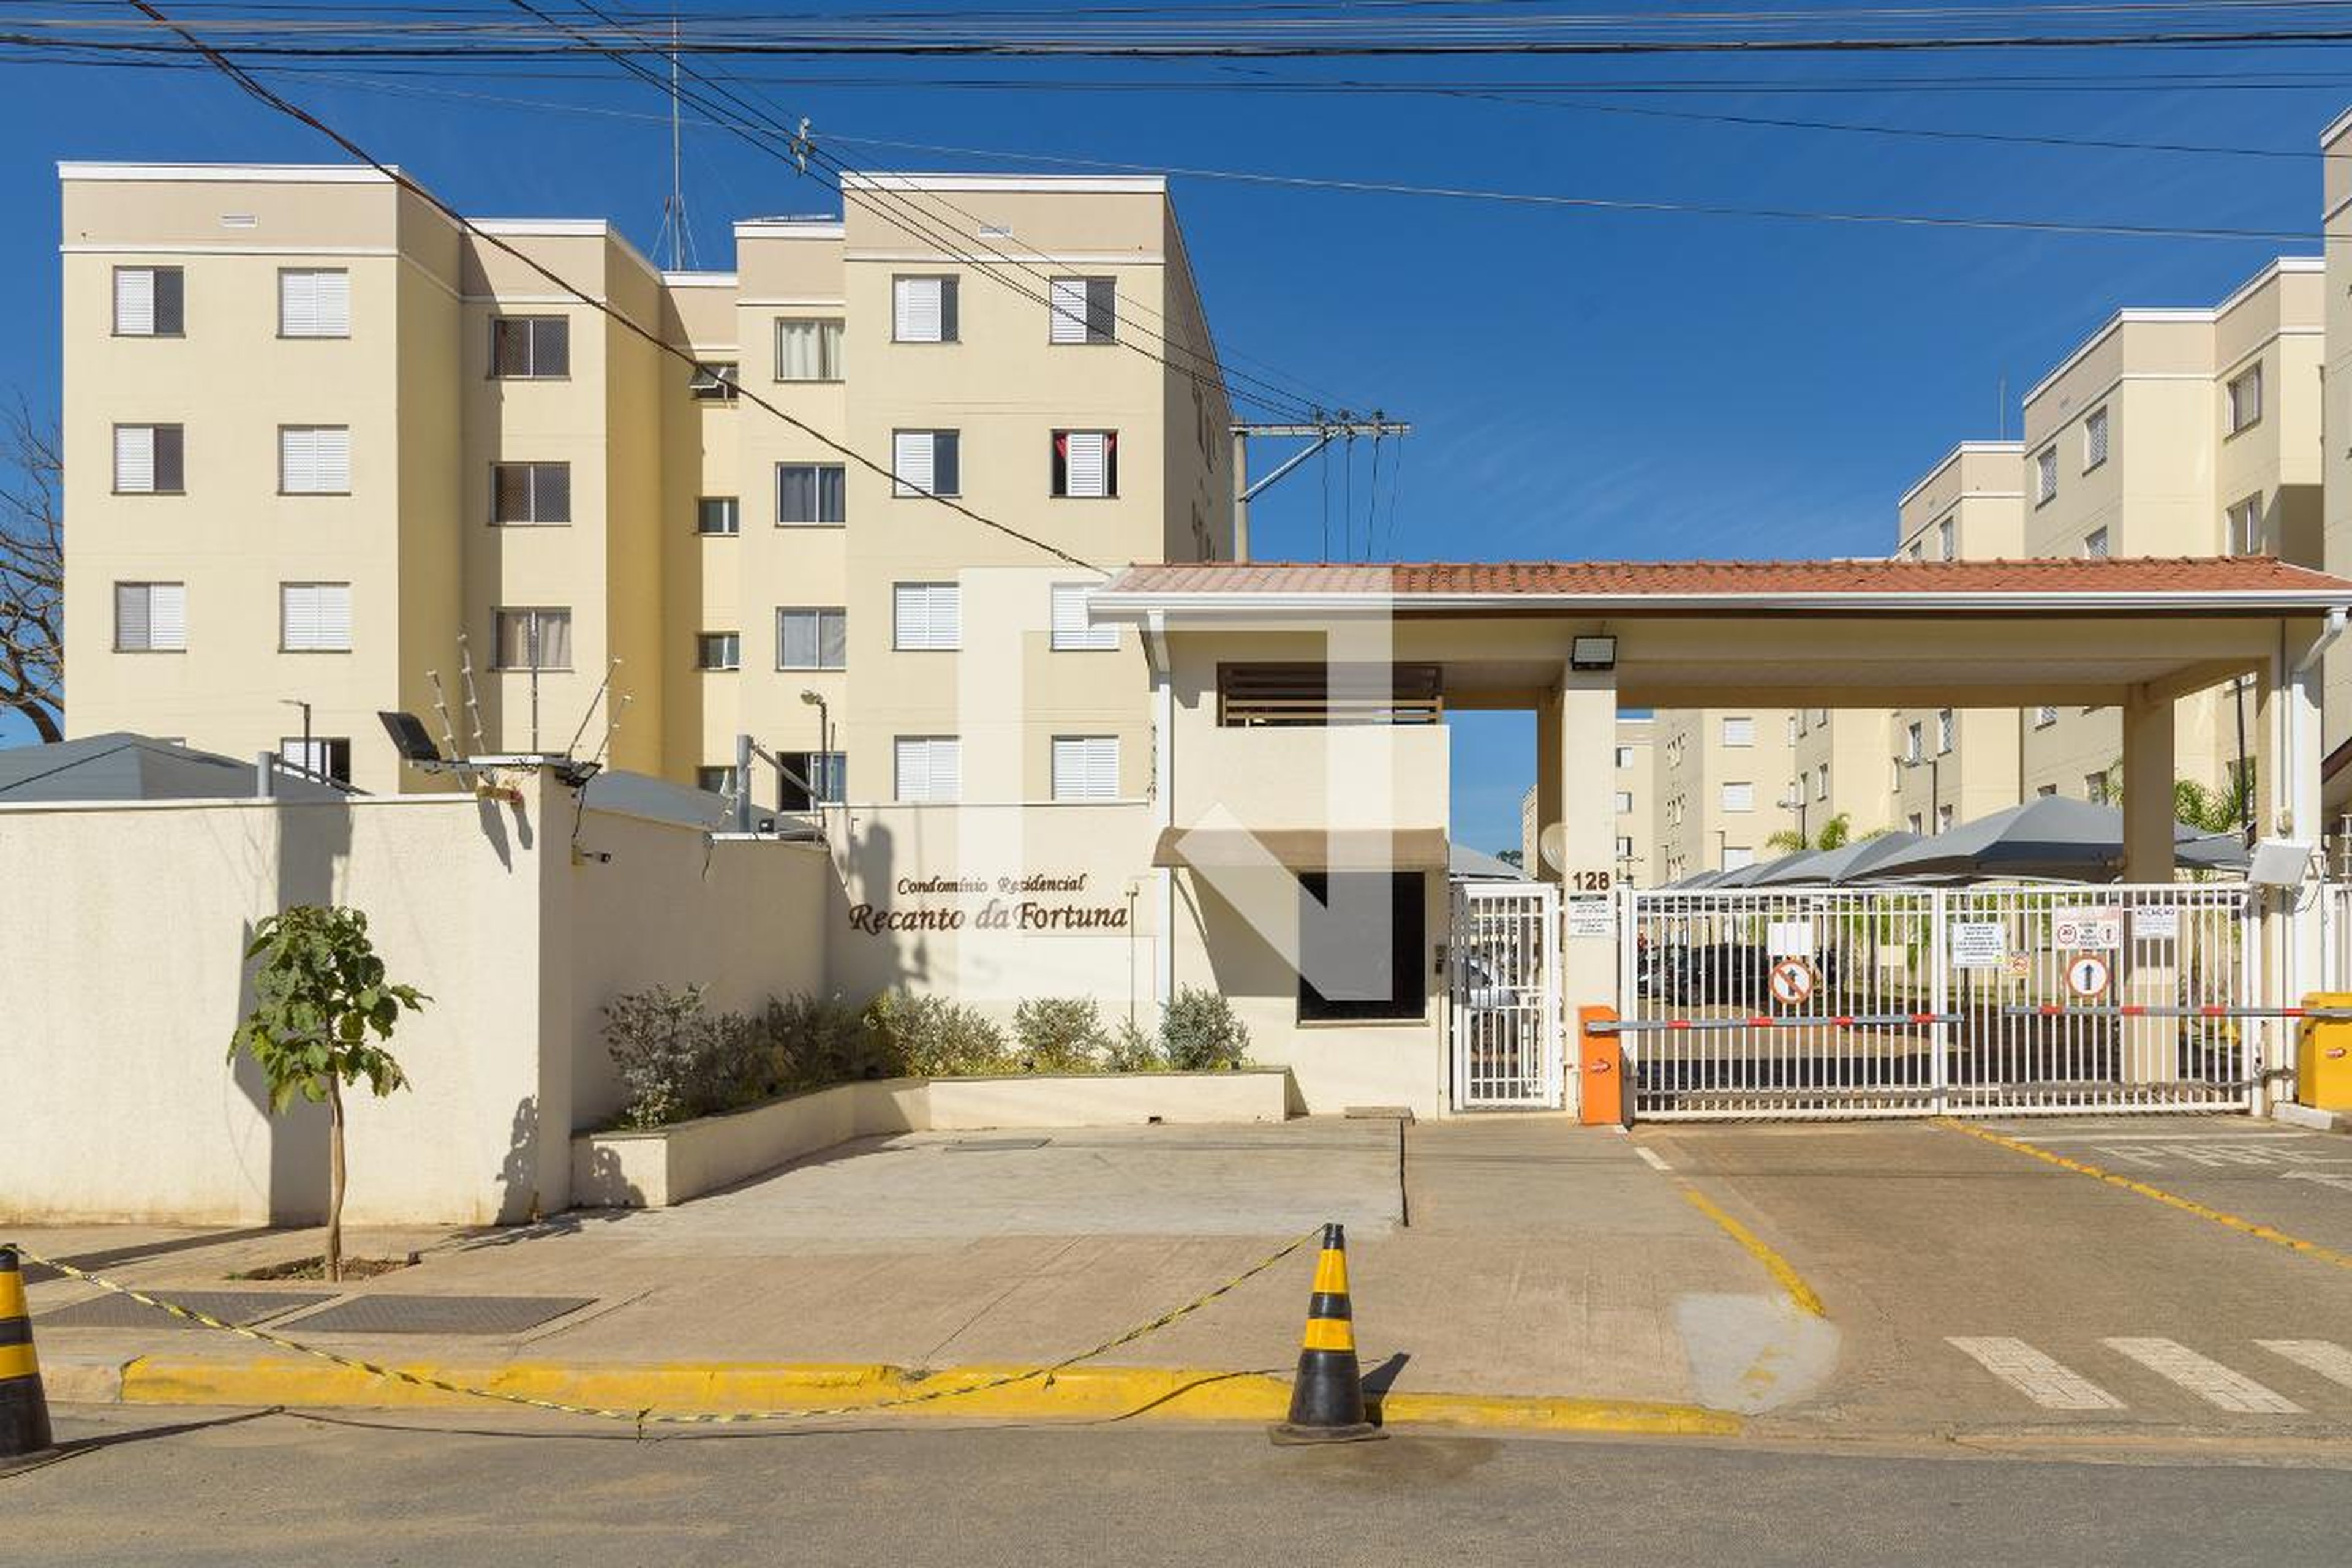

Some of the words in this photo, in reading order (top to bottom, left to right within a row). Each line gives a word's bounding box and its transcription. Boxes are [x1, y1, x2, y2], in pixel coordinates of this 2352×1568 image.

[998, 873, 1088, 894] Residencial
[1573, 871, 1610, 891] 128
[848, 903, 966, 936] Recanto
[975, 899, 1011, 930] da
[1012, 901, 1128, 930] Fortuna
